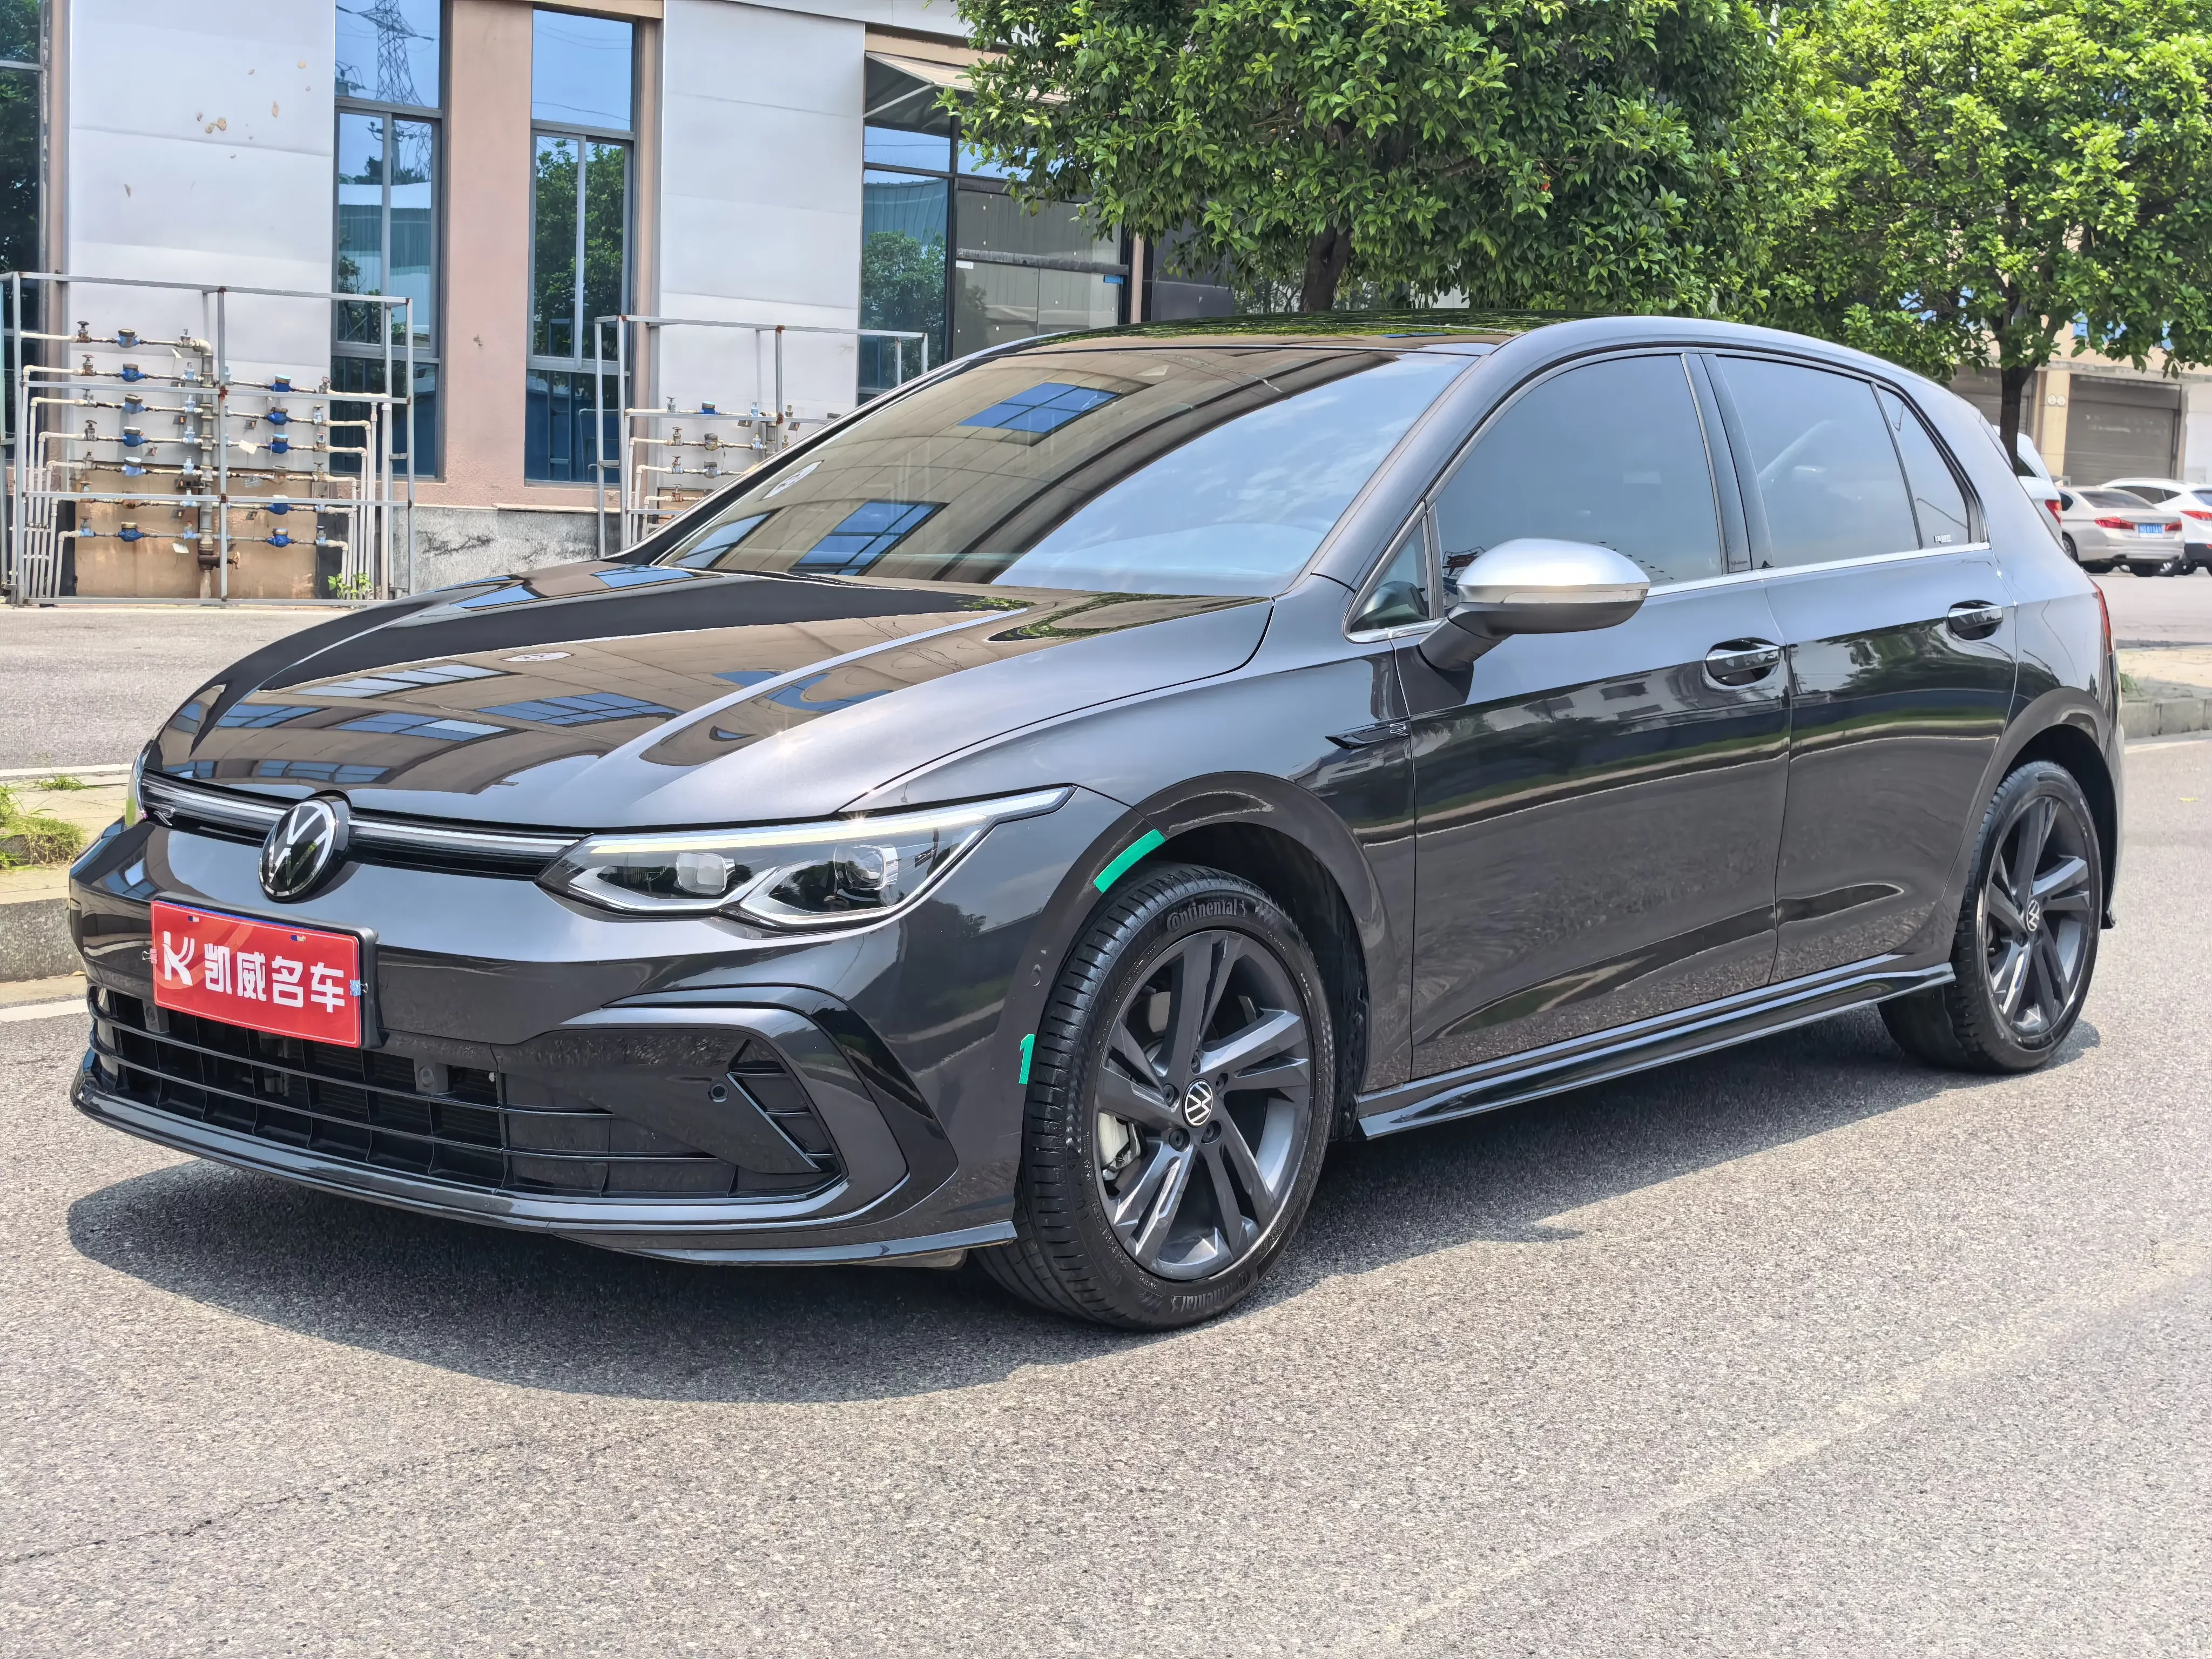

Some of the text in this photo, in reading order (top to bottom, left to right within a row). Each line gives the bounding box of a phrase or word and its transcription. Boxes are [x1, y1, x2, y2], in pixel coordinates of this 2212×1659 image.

[1166, 898, 1238, 933] Continental
[204, 943, 345, 1013] 凯威名车
